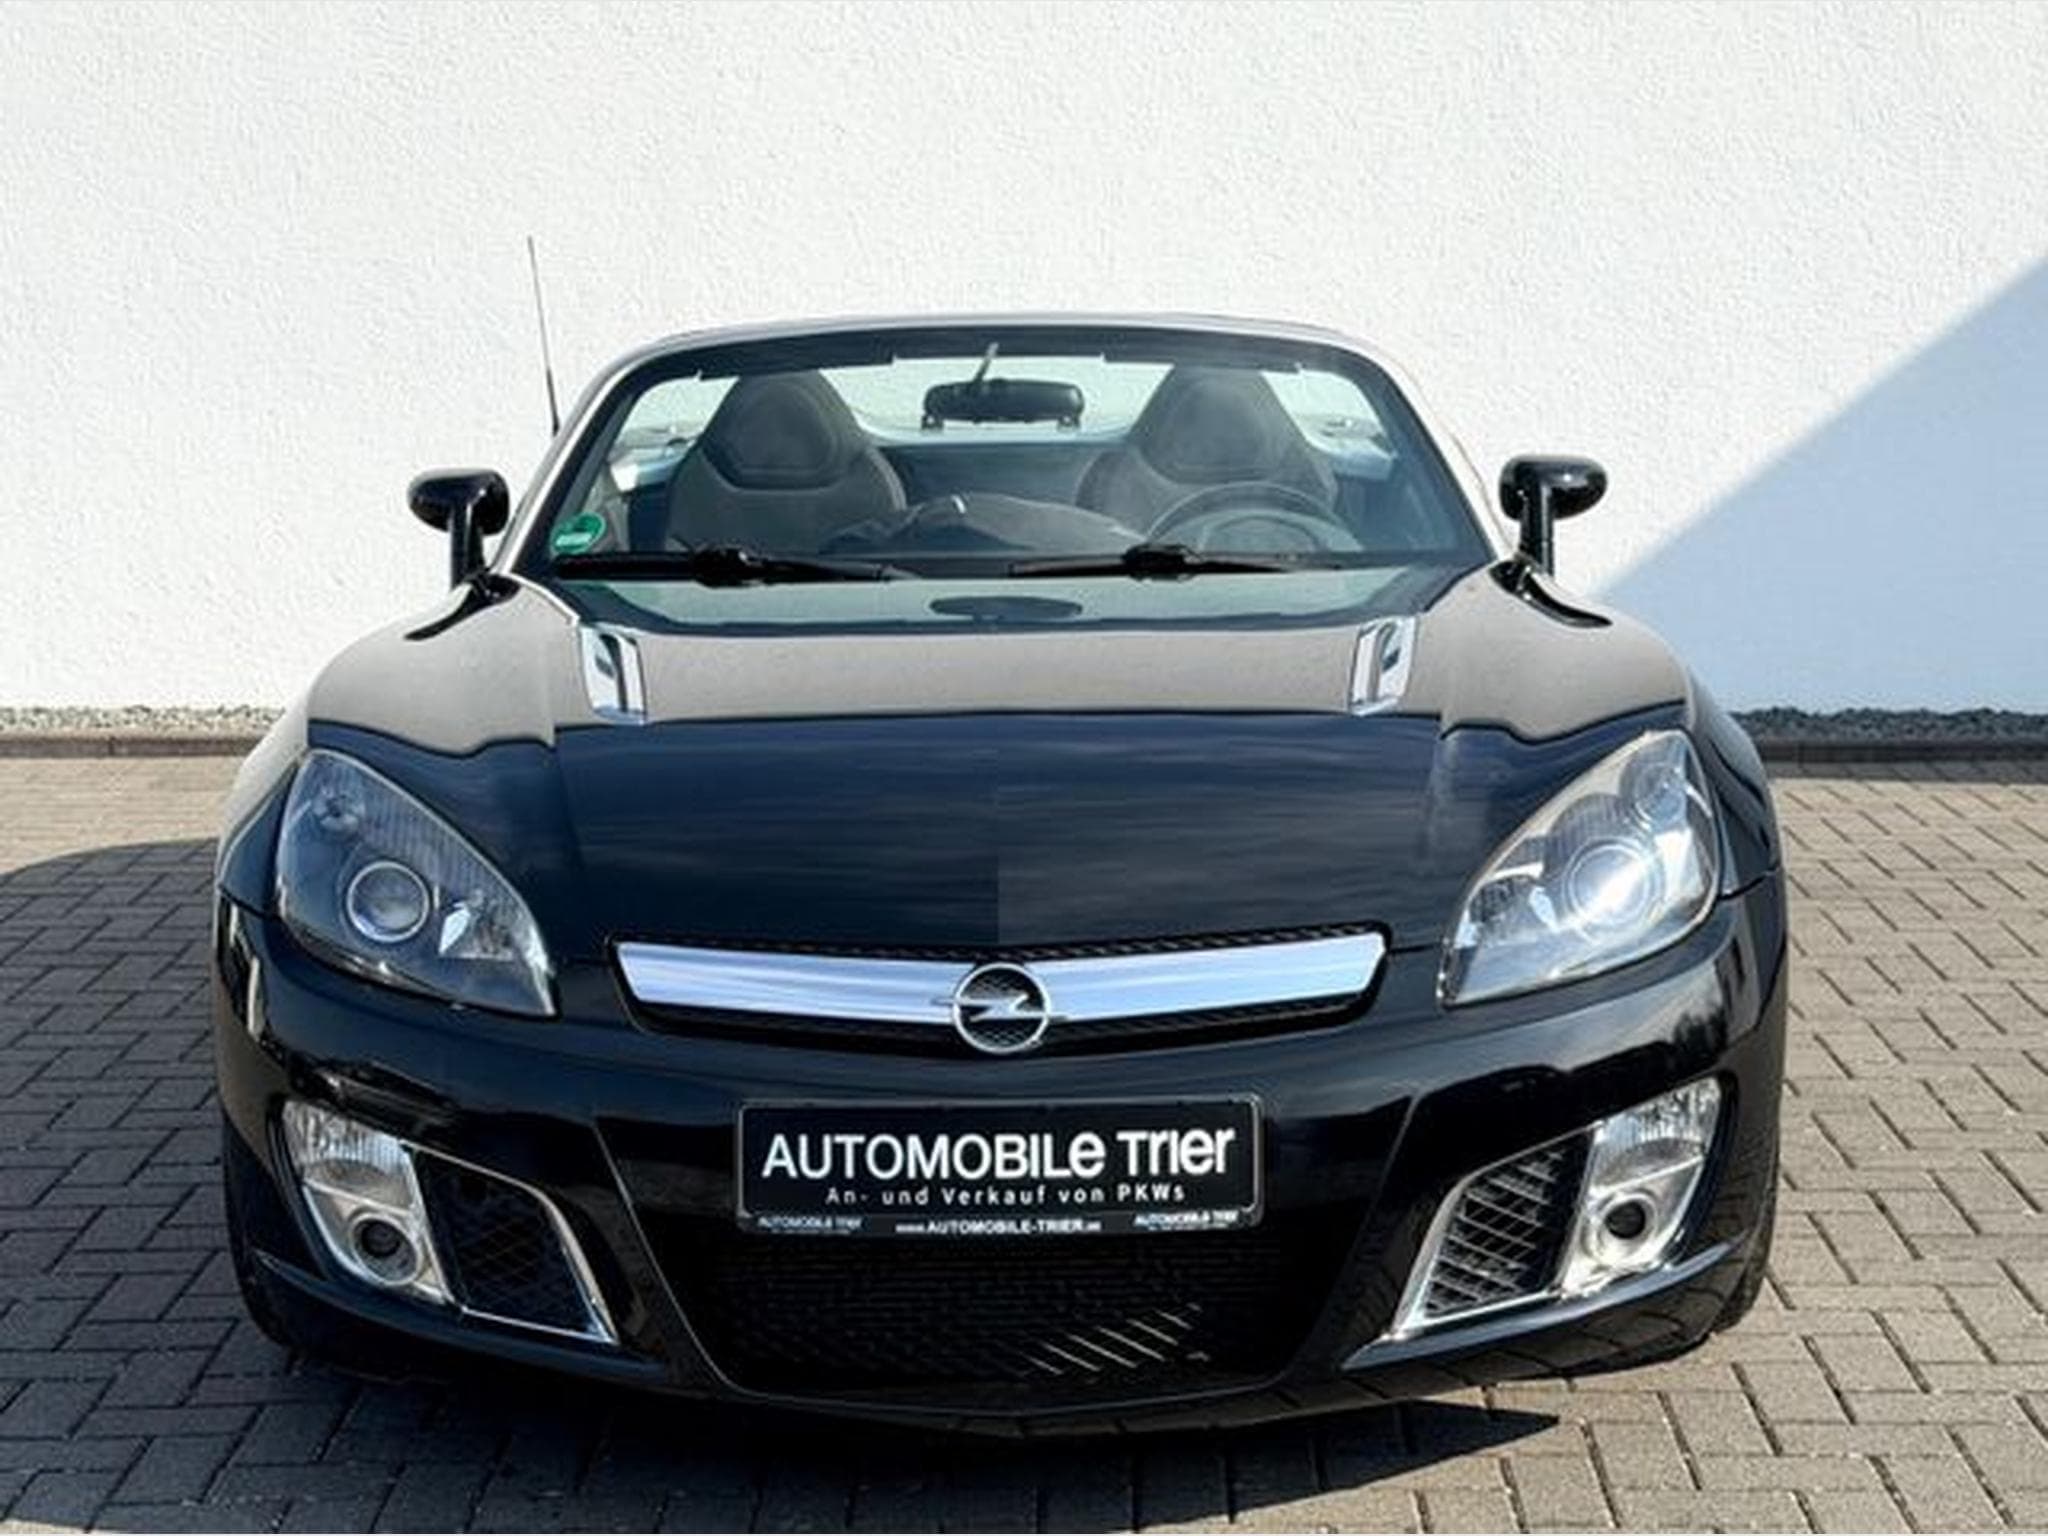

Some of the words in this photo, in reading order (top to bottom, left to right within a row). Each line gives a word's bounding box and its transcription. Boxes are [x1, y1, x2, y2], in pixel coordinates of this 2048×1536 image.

[825, 1186, 870, 1206] An-
[881, 1185, 930, 1206] und
[941, 1184, 1047, 1206] Verkauf
[1058, 1187, 1105, 1204] von
[1117, 1182, 1186, 1202] PKWs
